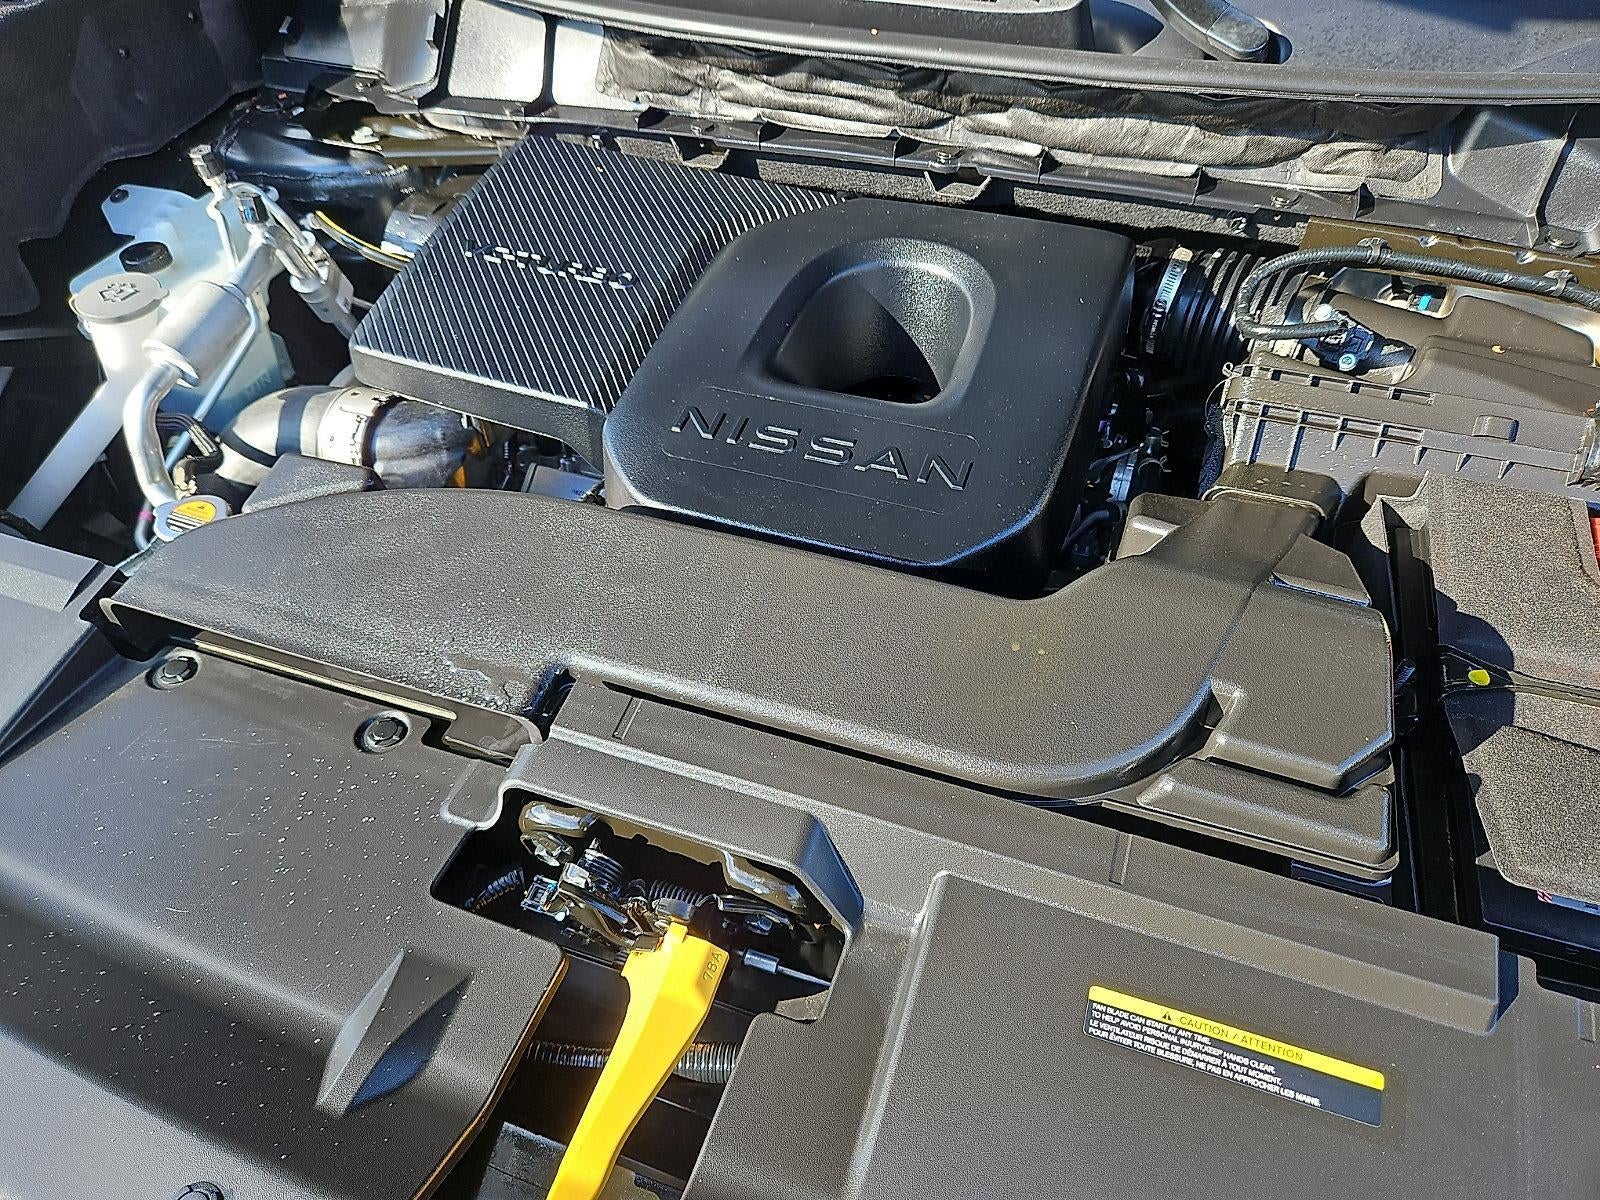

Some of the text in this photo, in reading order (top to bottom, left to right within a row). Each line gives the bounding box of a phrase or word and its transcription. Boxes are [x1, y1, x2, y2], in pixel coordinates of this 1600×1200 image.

[671, 406, 975, 491] NISSAN
[703, 952, 723, 980] 7BA
[1092, 1003, 1106, 1012] FAN
[1107, 1007, 1128, 1019] BLADE
[1130, 1014, 1146, 1024] CAN
[1146, 1018, 1168, 1030] START
[1168, 1025, 1177, 1033] AT
[1178, 1028, 1194, 1038] ANY
[1092, 1010, 1101, 1018] TO
[1102, 1014, 1120, 1024] HELP
[1120, 1019, 1142, 1030] AVOID
[1142, 1024, 1178, 1042] PERSONAL
[1223, 1052, 1249, 1062] HANDS
[1180, 1016, 1228, 1037] CAUTION
[1241, 1036, 1302, 1061] ATTENTION
[1089, 1027, 1108, 1039] POUR
[1134, 1040, 1156, 1054] TOUTE
[1196, 1060, 1206, 1070] NE
[1207, 1064, 1222, 1074] PAS
[1222, 1068, 1234, 1078] EN
[1234, 1074, 1280, 1094] APPROCHER
[1280, 1087, 1295, 1098] LES
[1090, 1020, 1098, 1028] LE
[1099, 1022, 1143, 1040] VENTILATEUR
[1144, 1034, 1170, 1049] RISQUE
[1171, 1042, 1181, 1052] DE
[1228, 1062, 1248, 1074] TOUT
